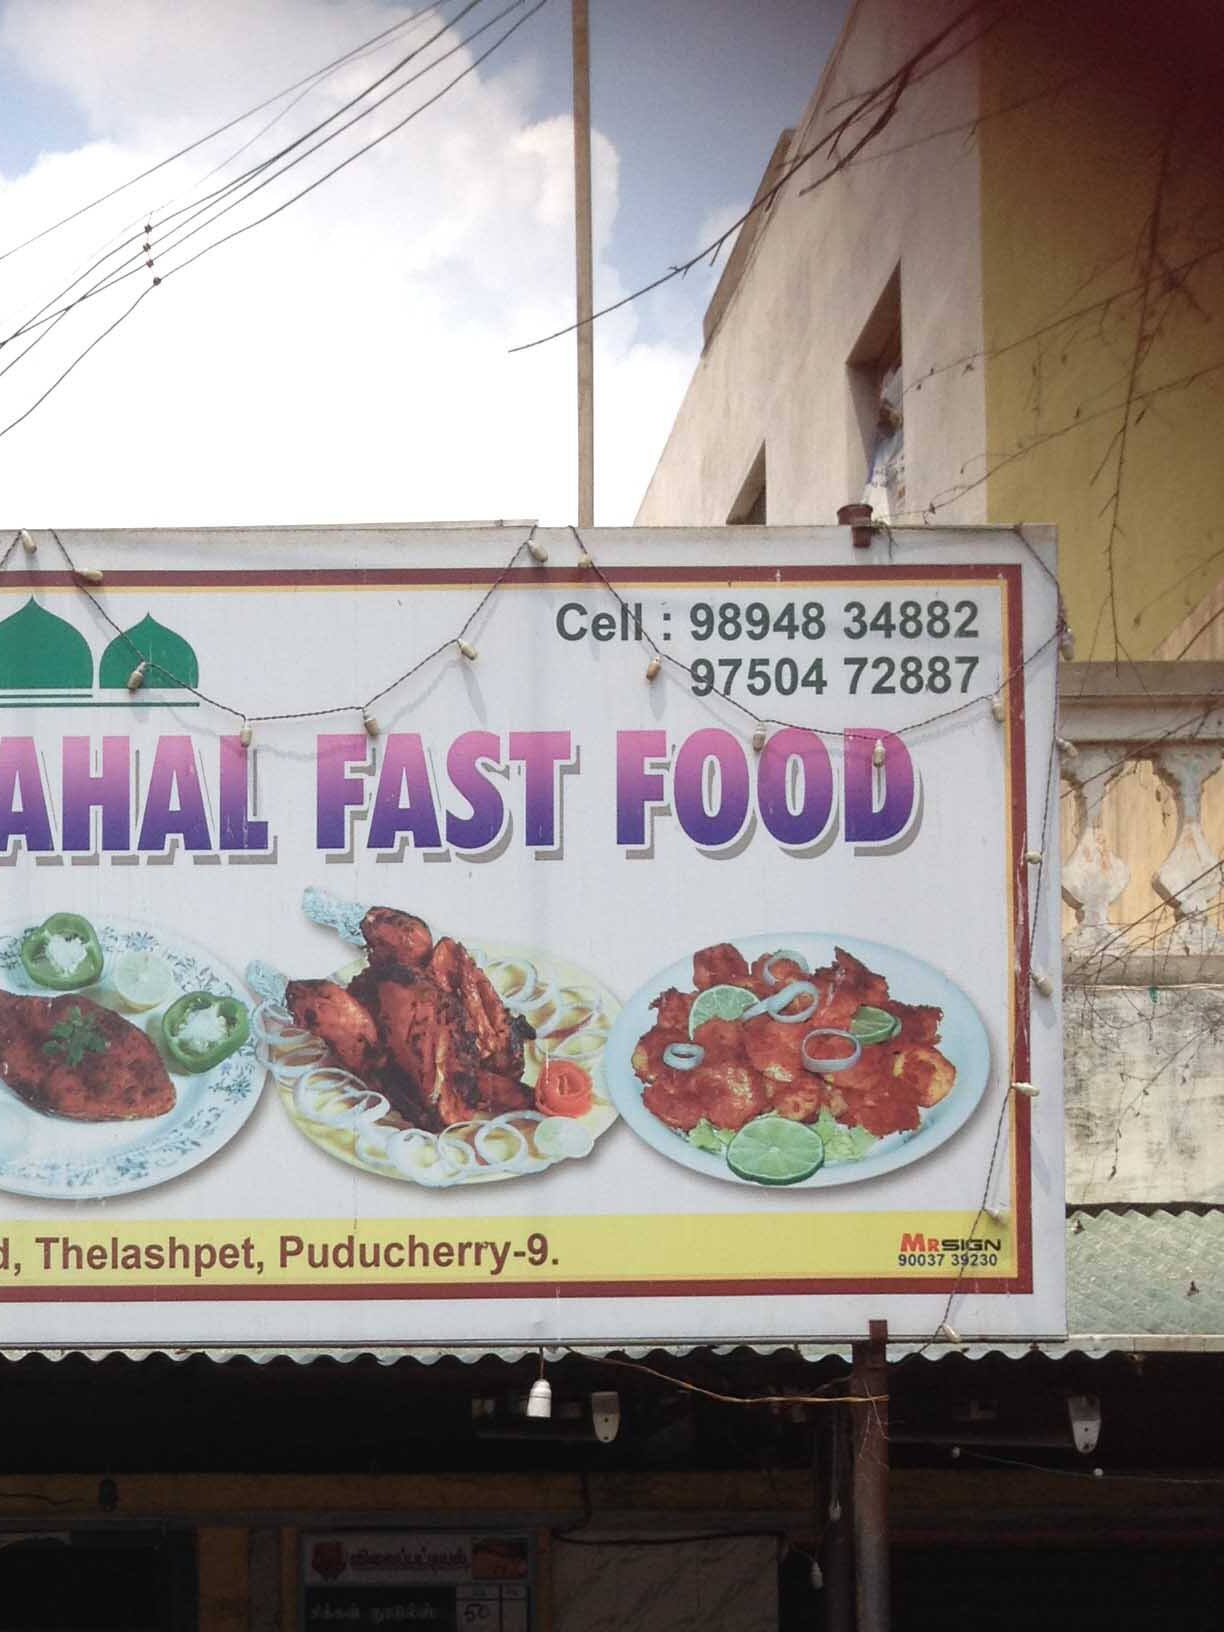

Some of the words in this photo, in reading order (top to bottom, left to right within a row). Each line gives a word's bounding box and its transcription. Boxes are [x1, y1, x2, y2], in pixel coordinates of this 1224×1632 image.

[556, 602, 644, 642] Cell
[689, 601, 827, 641] 98948
[843, 600, 980, 639] 34882
[690, 657, 828, 697] 97504
[843, 655, 980, 695] 72887
[316, 730, 573, 852] FAST
[616, 726, 916, 846] FOOD
[35, 1236, 265, 1277] Thelashpet,
[279, 1233, 560, 1276] Puducherry-9.
[898, 1254, 945, 1267] 90037
[951, 1253, 998, 1267] 39230
